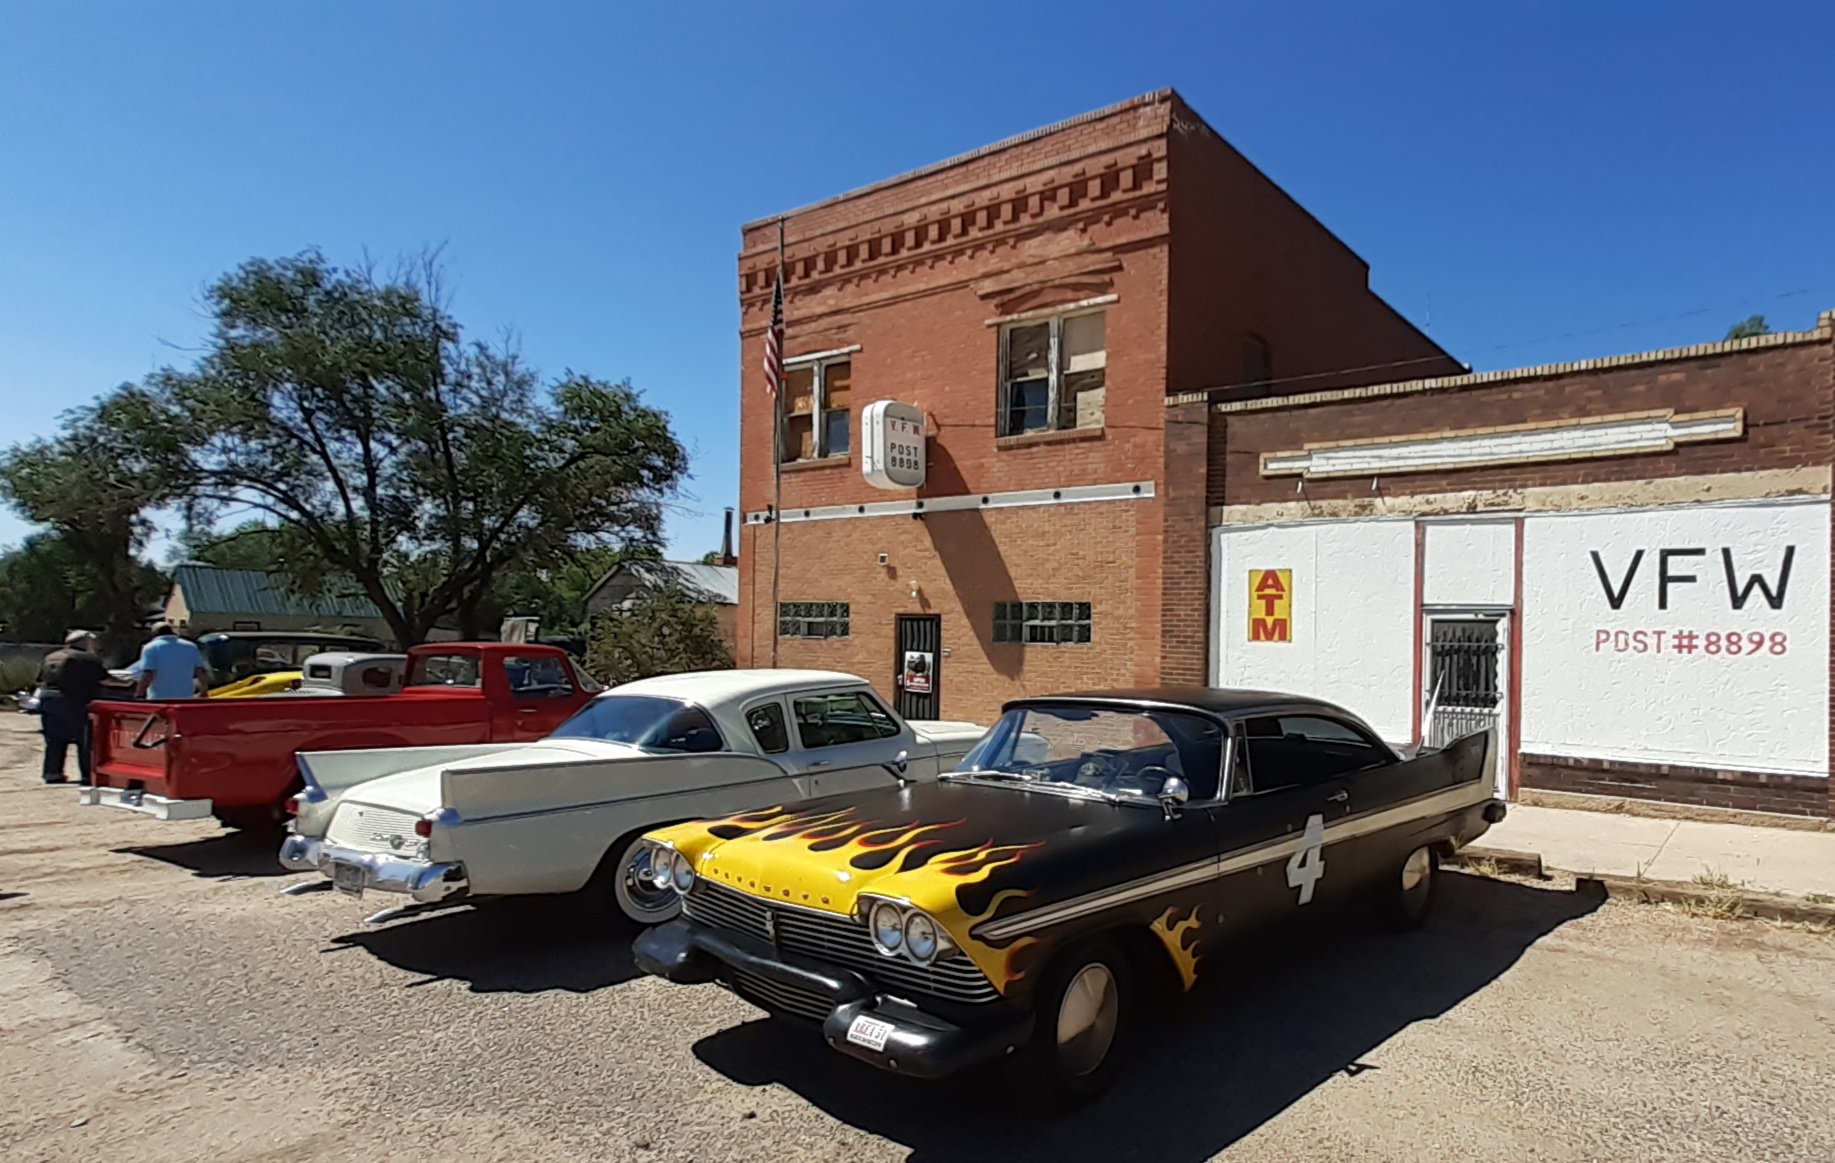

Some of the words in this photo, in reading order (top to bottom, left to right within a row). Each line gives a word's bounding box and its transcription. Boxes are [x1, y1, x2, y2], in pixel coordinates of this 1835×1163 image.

[890, 442, 919, 458] POST
[891, 456, 920, 471] 8898
[1251, 569, 1288, 642] ATM
[1589, 544, 1797, 611] VFW
[1285, 813, 1326, 906] 4
